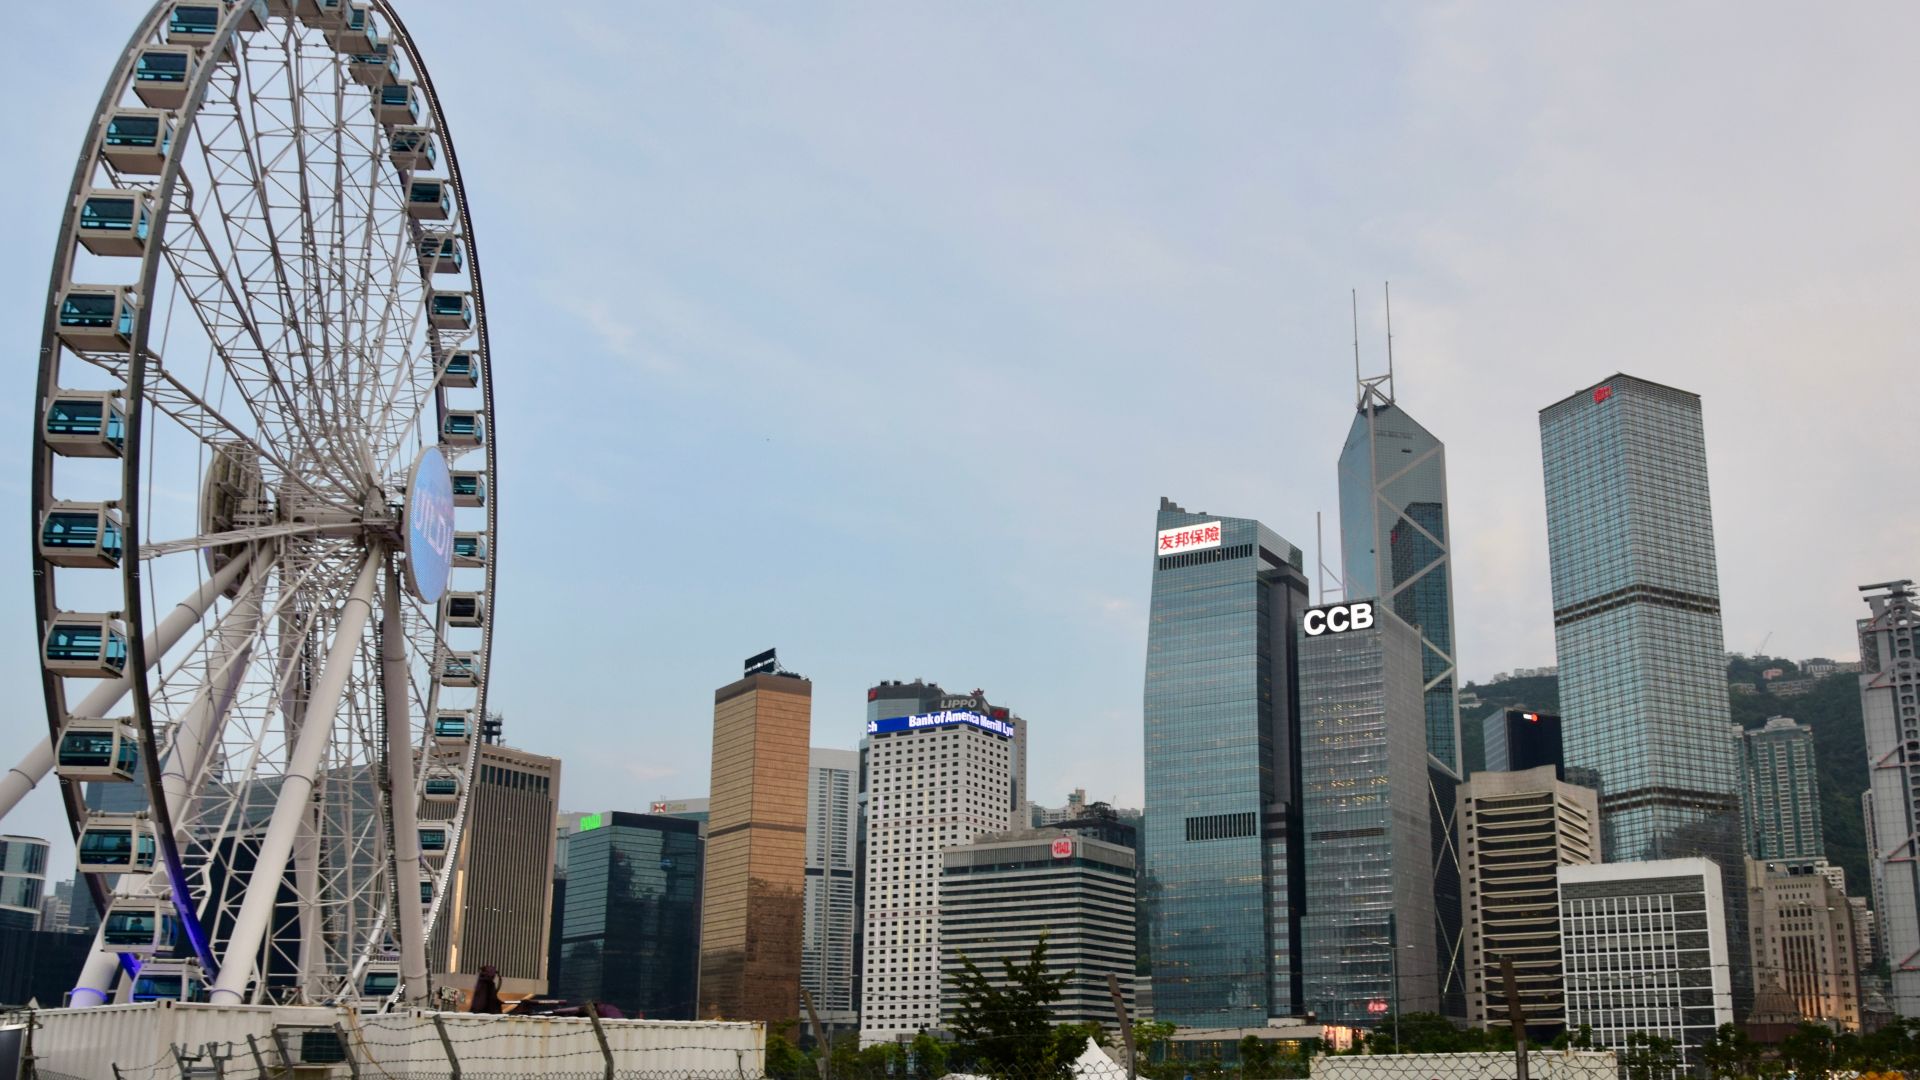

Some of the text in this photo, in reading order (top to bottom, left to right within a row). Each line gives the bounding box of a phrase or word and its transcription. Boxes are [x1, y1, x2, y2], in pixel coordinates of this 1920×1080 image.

[1160, 526, 1220, 550] 友邦保險
[1303, 602, 1374, 636] CCB
[940, 698, 977, 709] LIPPO
[909, 714, 935, 727] Bank
[934, 712, 945, 724] of
[945, 711, 980, 725] America
[981, 715, 1002, 732] Merrill
